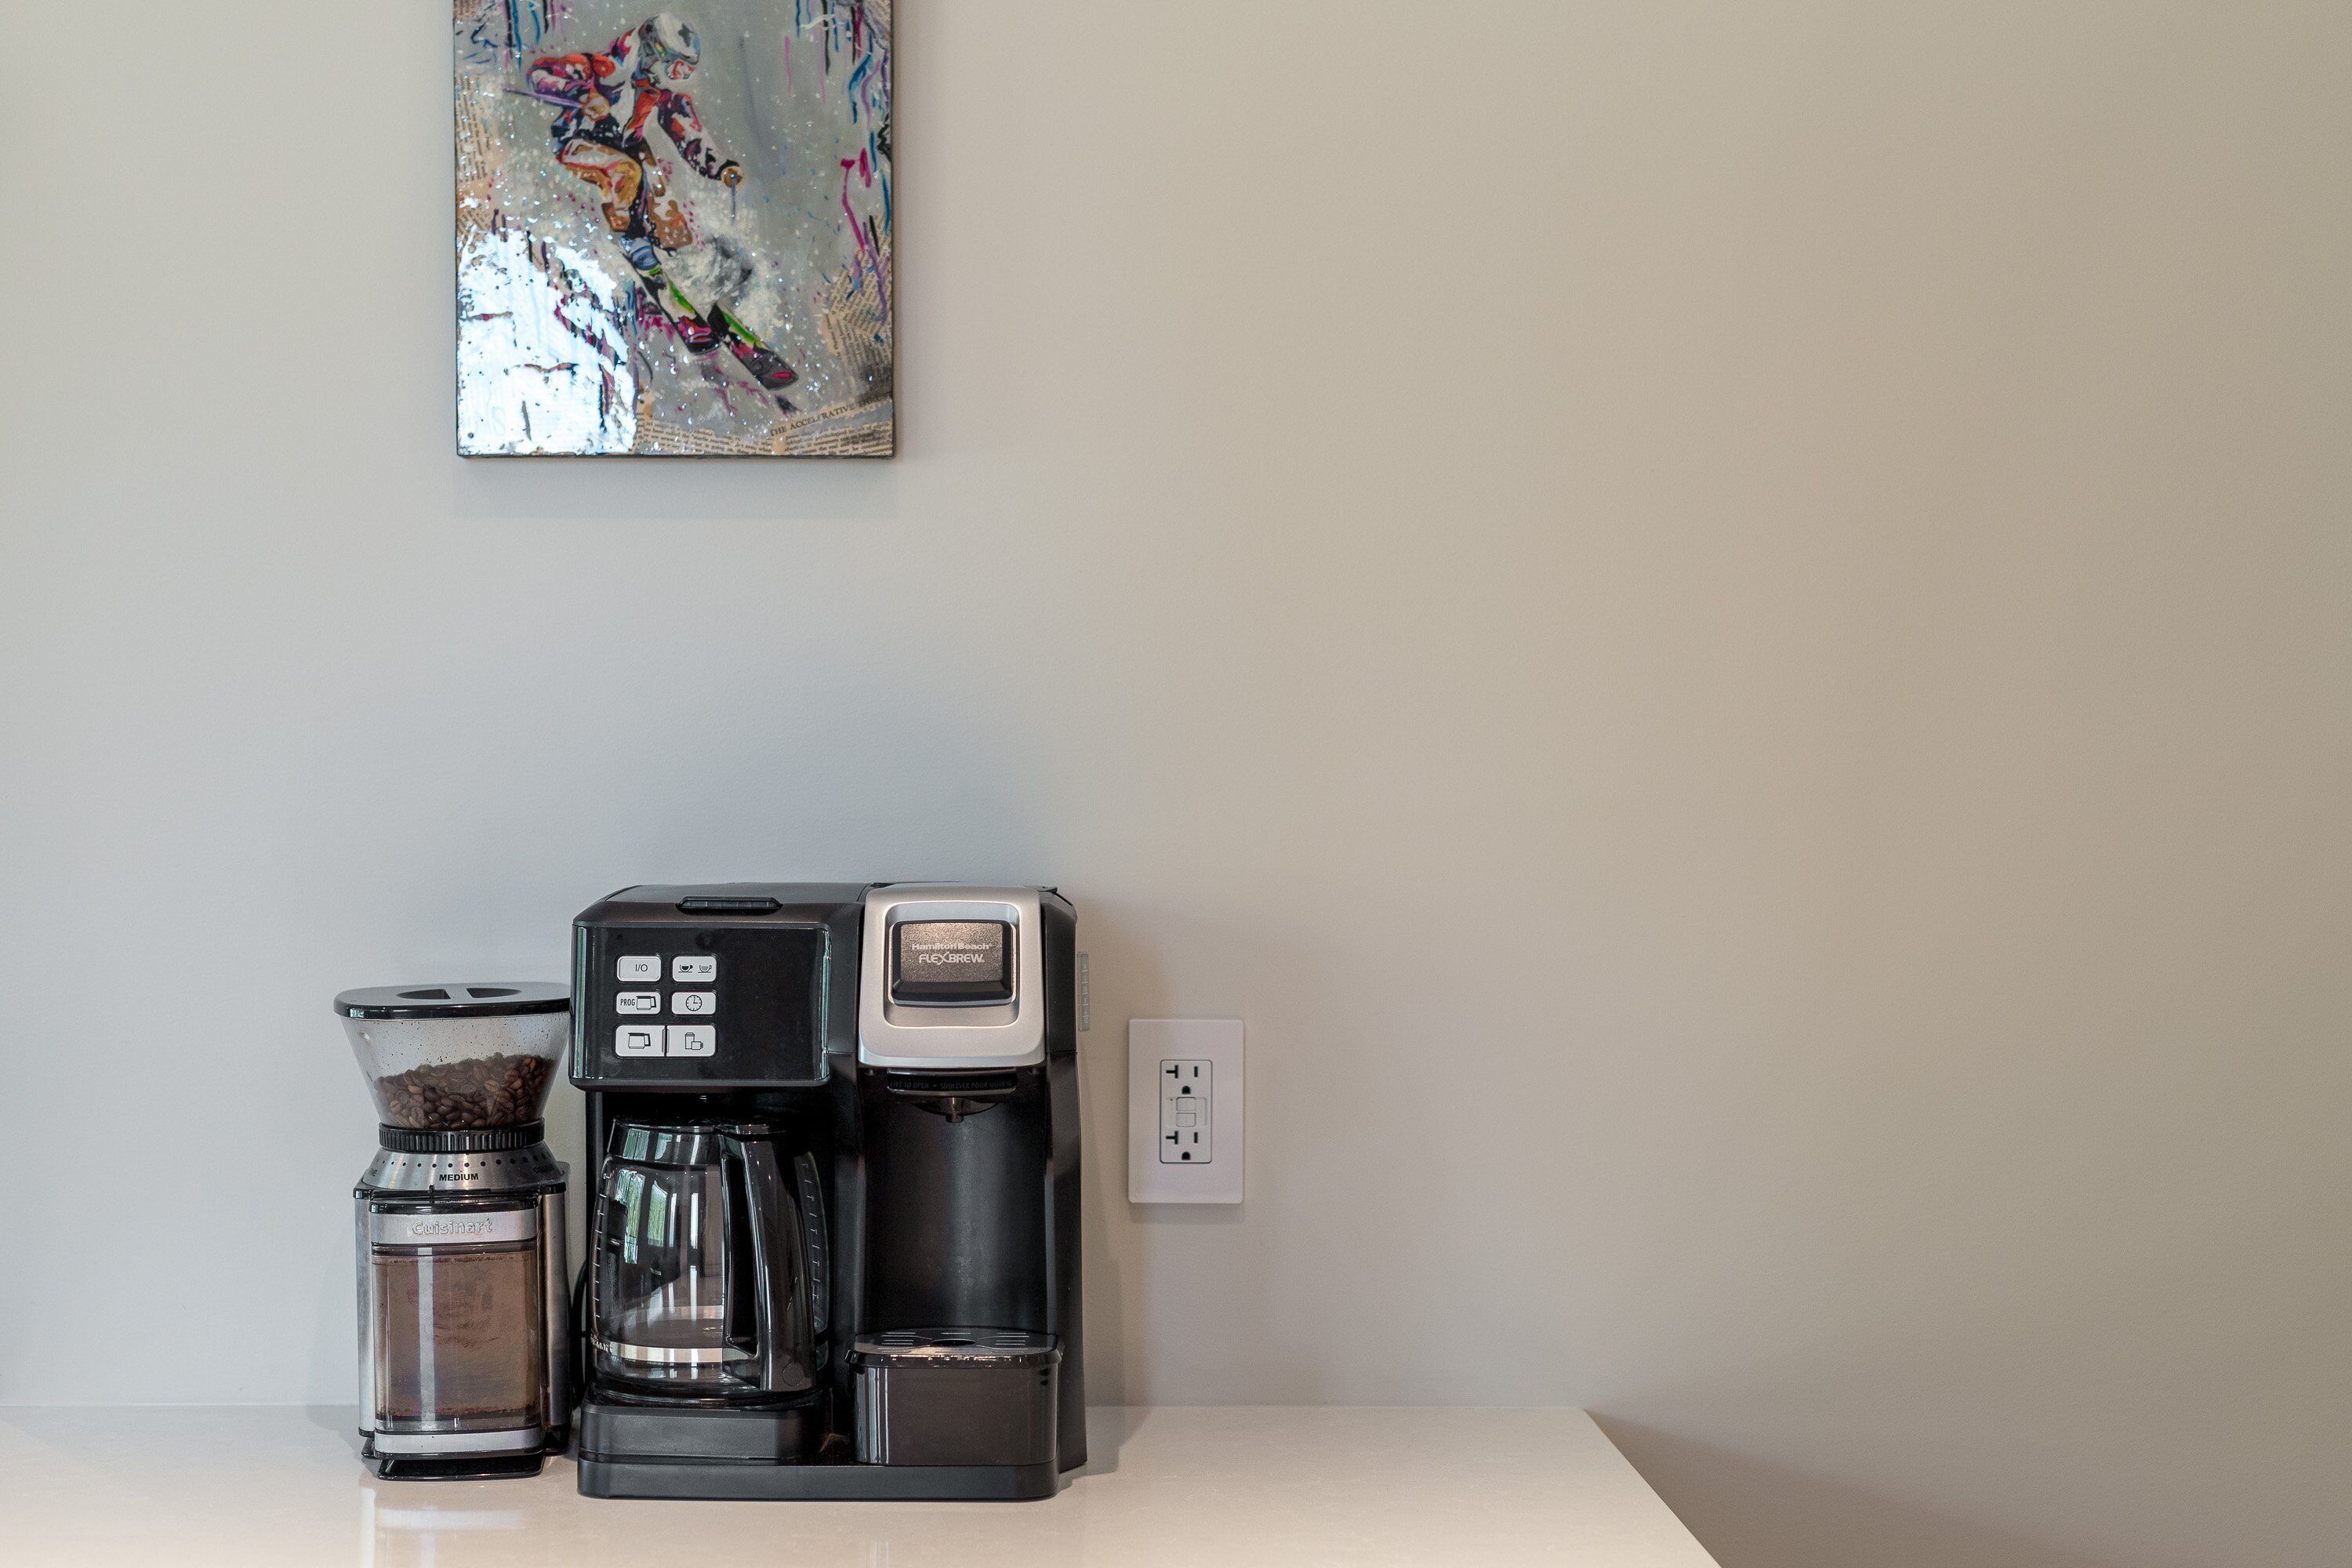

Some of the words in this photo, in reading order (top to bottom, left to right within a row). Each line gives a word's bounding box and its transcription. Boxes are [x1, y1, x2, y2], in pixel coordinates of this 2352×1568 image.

[770, 426, 787, 437] THE
[635, 964, 648, 972] I/O
[620, 998, 636, 1007] PROG
[438, 1173, 479, 1182] MEDIUM
[412, 1218, 492, 1236] Cuisinart
